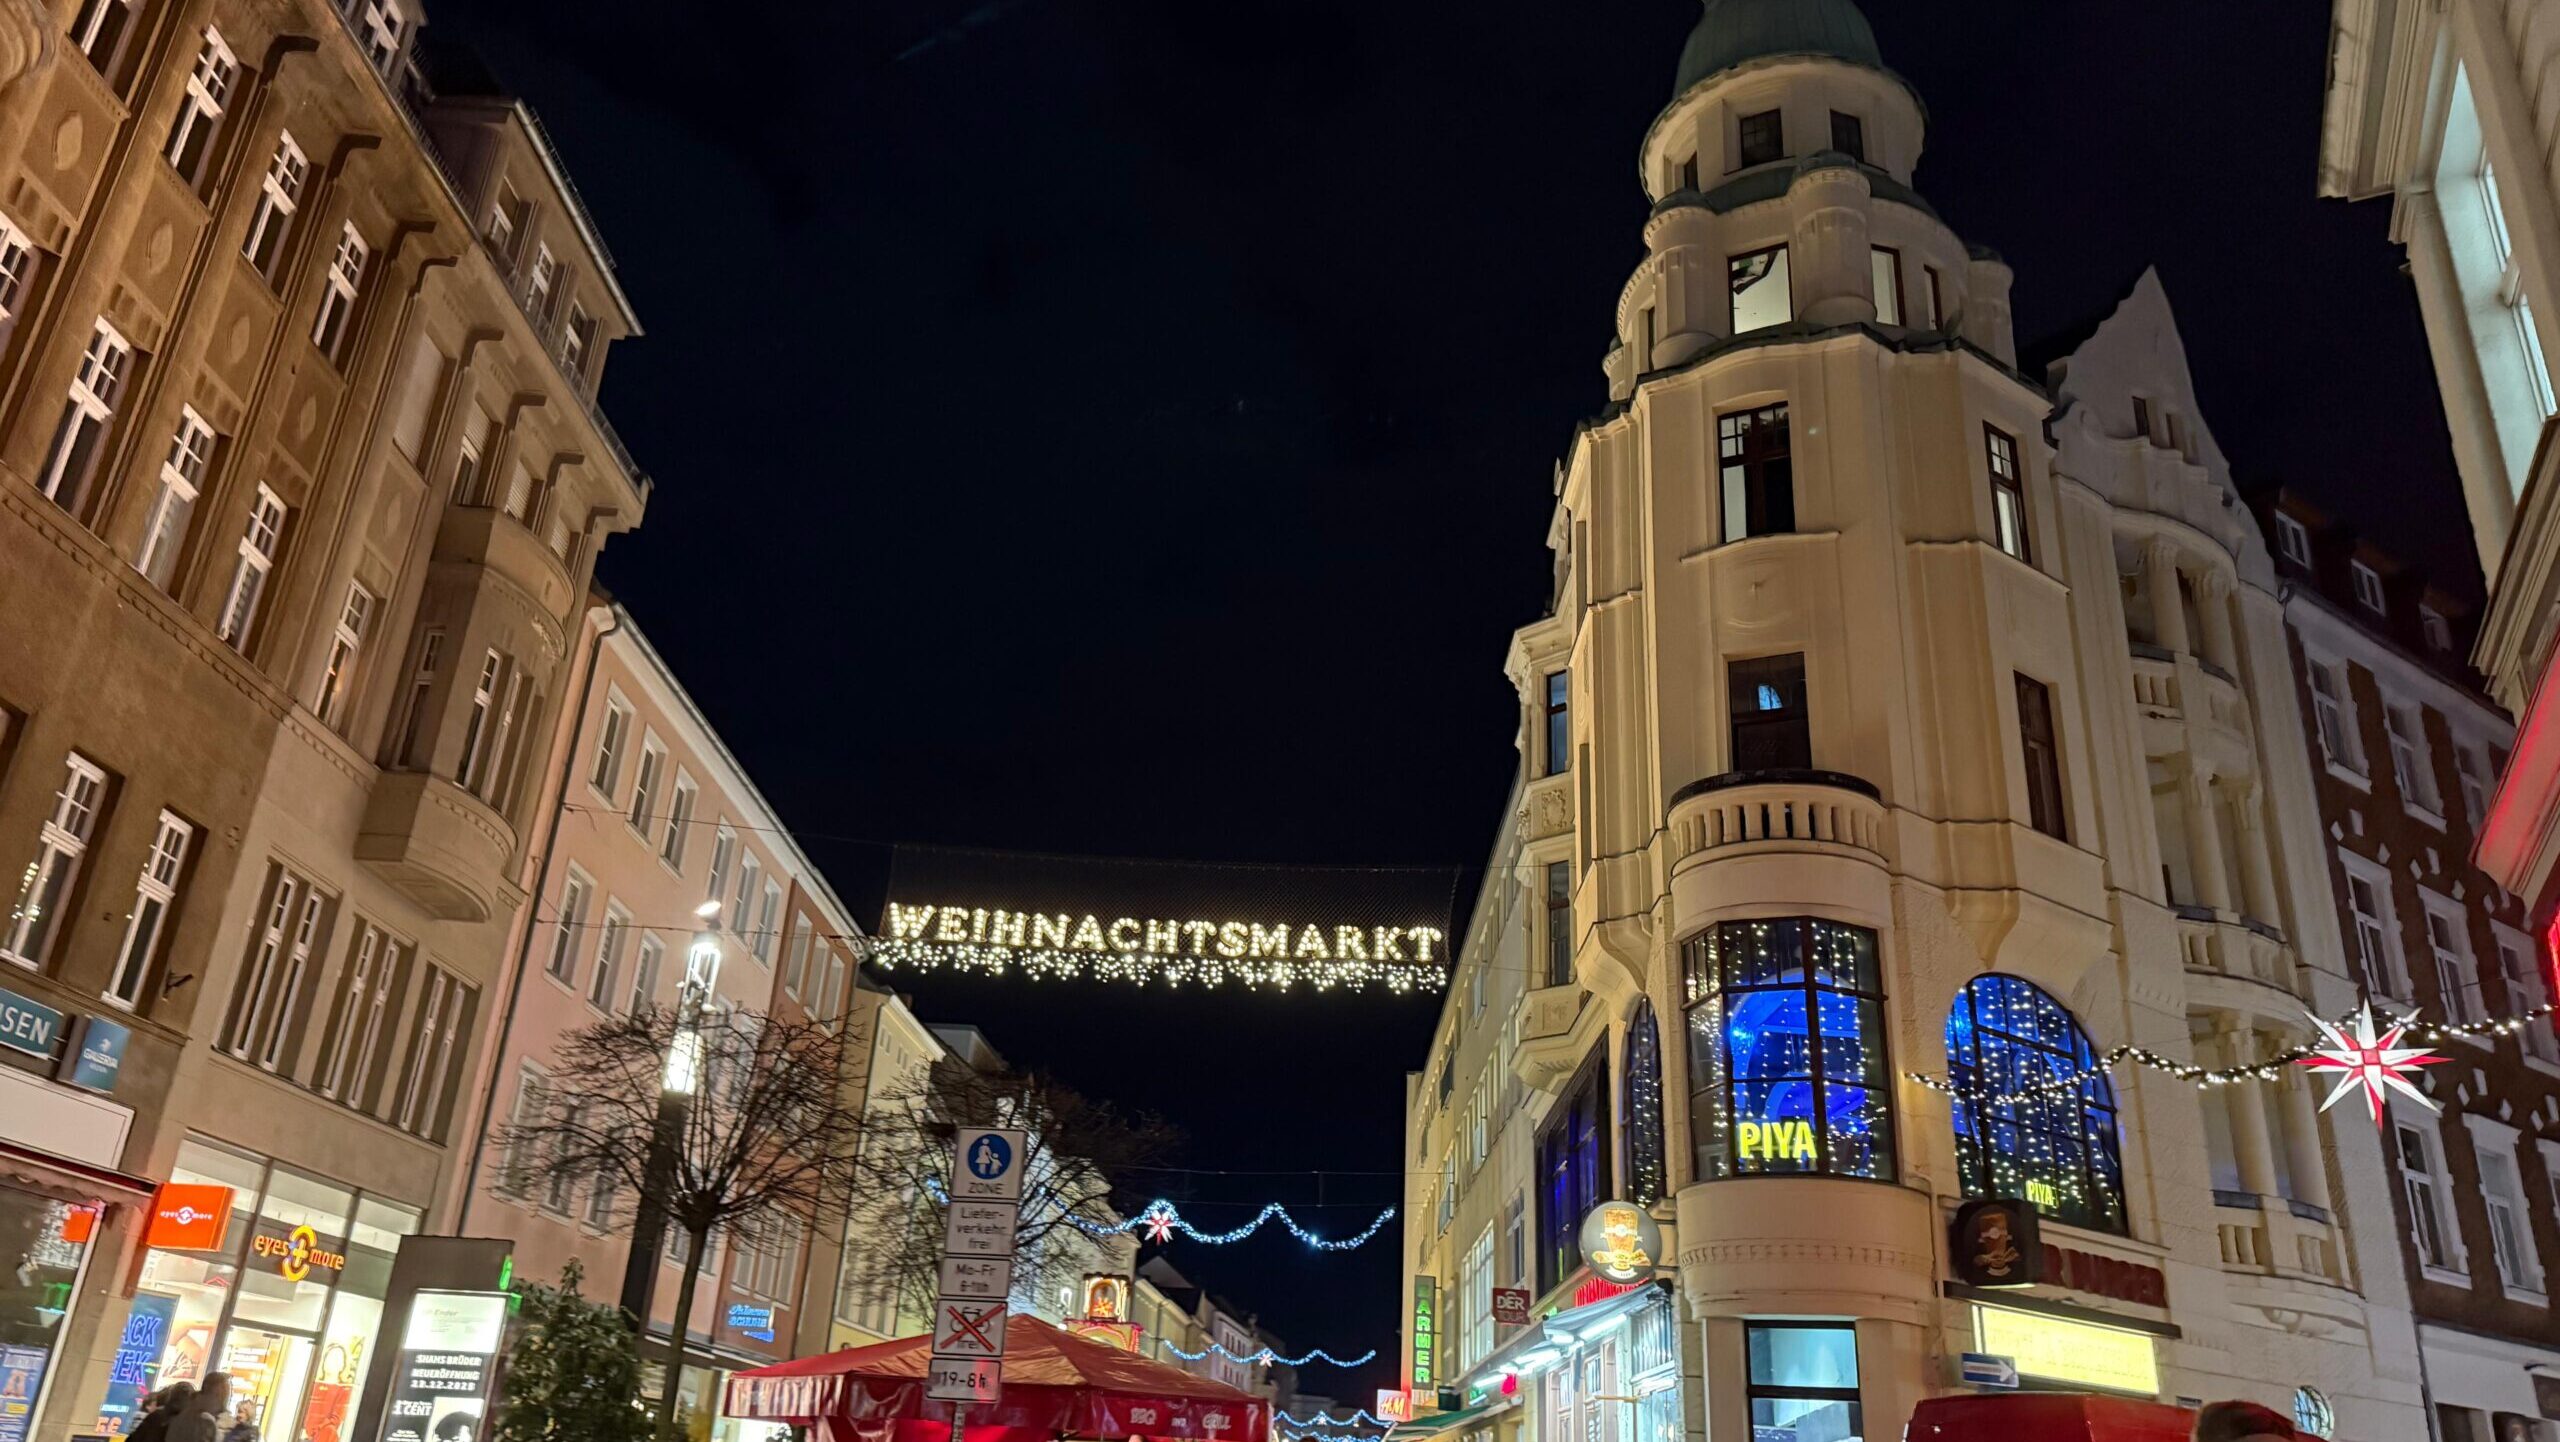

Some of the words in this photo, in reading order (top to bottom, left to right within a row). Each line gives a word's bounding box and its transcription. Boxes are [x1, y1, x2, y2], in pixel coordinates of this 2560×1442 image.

[888, 902, 1442, 961] WEIHNACHTSMARKT
[0, 1003, 52, 1045] SEN
[1739, 1121, 1818, 1158] PIYA
[968, 1182, 1004, 1194] ZONE
[2026, 1179, 2054, 1206] PIYA
[160, 1210, 179, 1219] eyes
[192, 1212, 214, 1220] more
[960, 1207, 1005, 1219] Liefer-
[956, 1223, 1007, 1234] verkehr
[254, 1234, 289, 1258] eyes
[309, 1249, 345, 1270] more
[968, 1238, 992, 1249] frei
[956, 1263, 996, 1275] Mo-Fr
[1496, 1294, 1525, 1310] DER
[1415, 1285, 1431, 1383] BARMER
[403, 1404, 432, 1415] CENT
[1381, 1396, 1405, 1415] H&M
[1130, 1408, 1157, 1425] BBQ
[1202, 1413, 1232, 1430] GRILL
